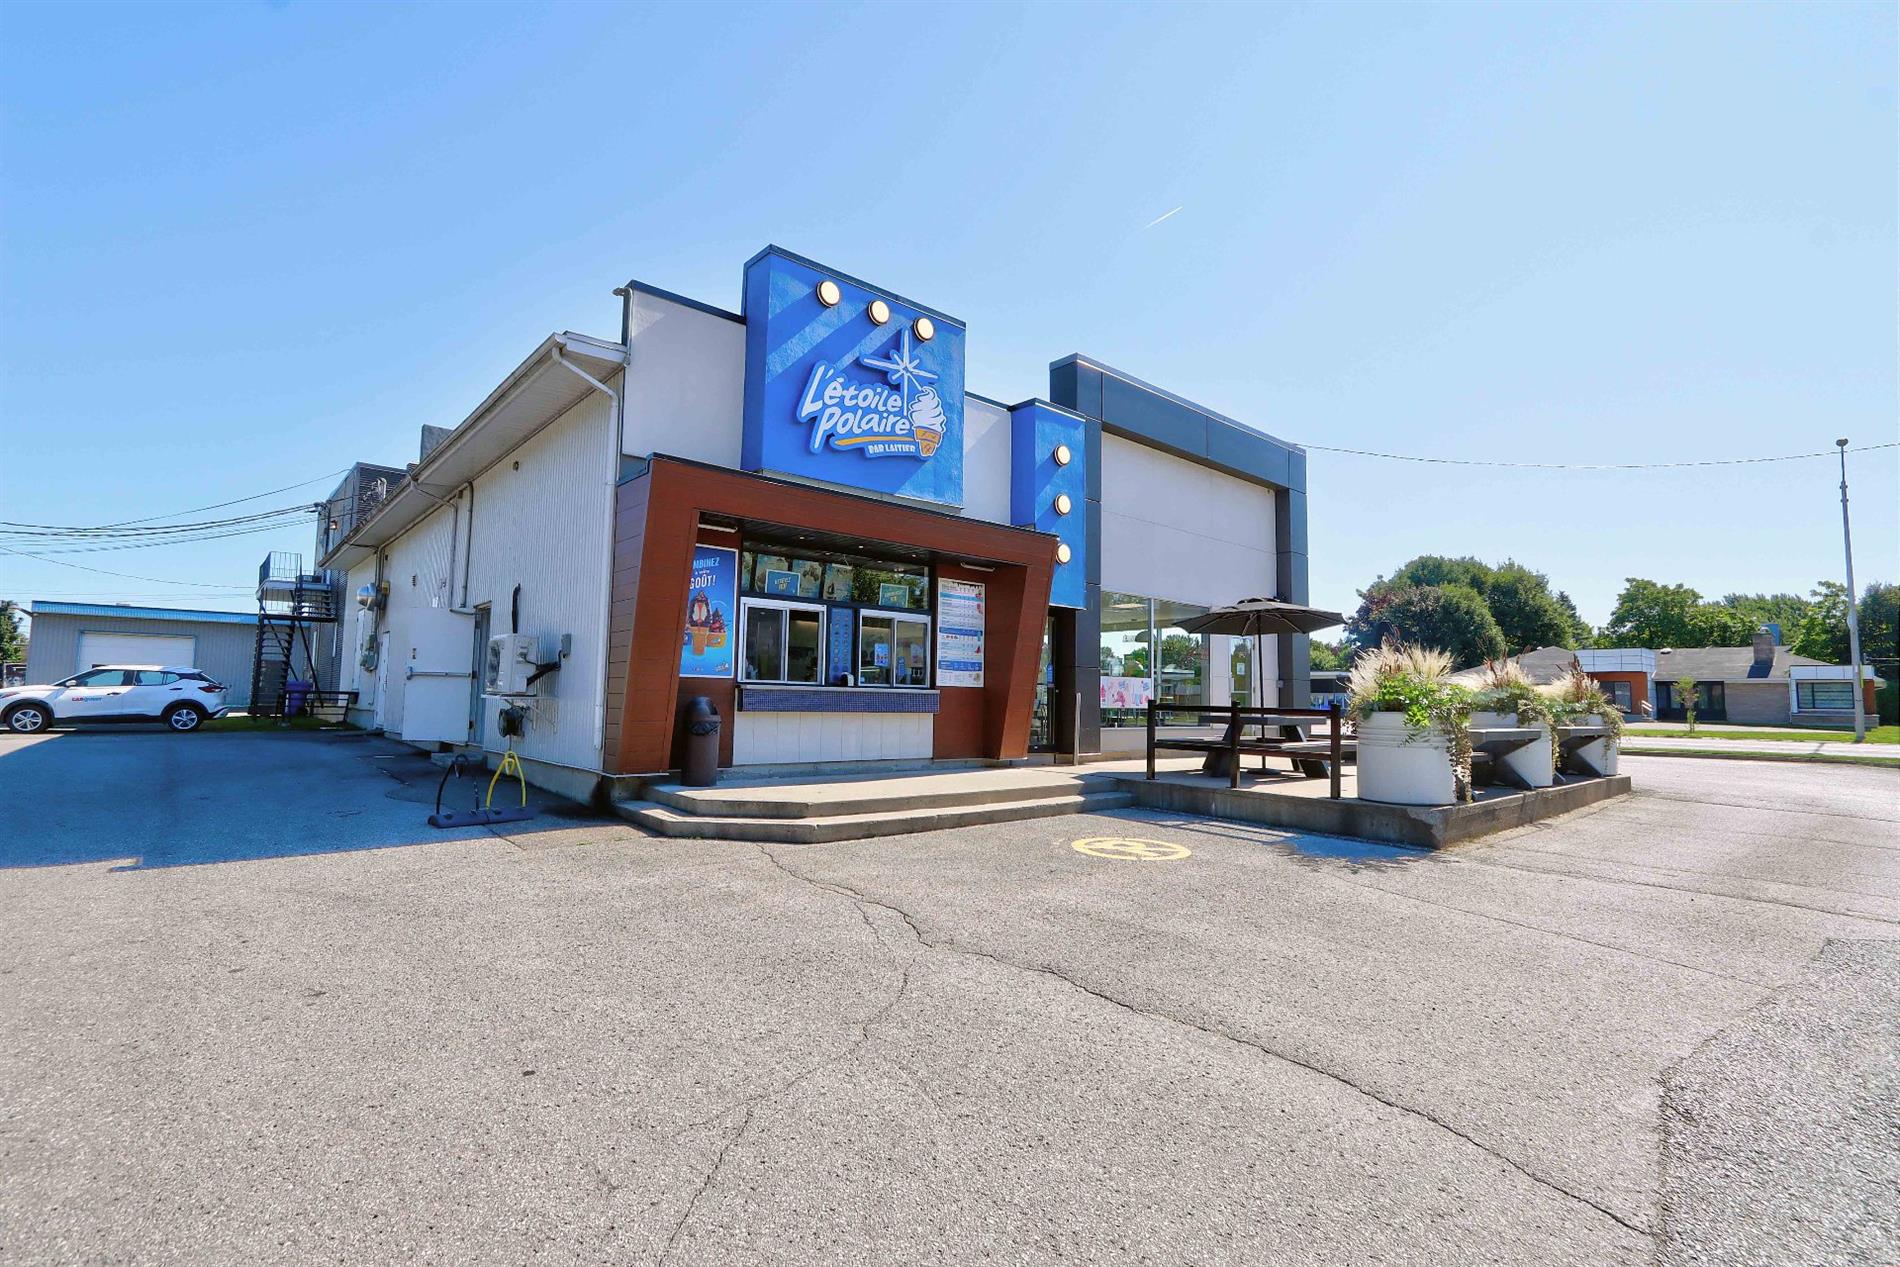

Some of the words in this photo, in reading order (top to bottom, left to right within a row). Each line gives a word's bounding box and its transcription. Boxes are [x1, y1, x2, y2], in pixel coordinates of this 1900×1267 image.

[801, 364, 902, 417] L'étoile
[814, 406, 911, 449] Polaire
[867, 444, 884, 454] BAR
[885, 443, 916, 453] LAITIER
[693, 557, 720, 569] MBINEZ
